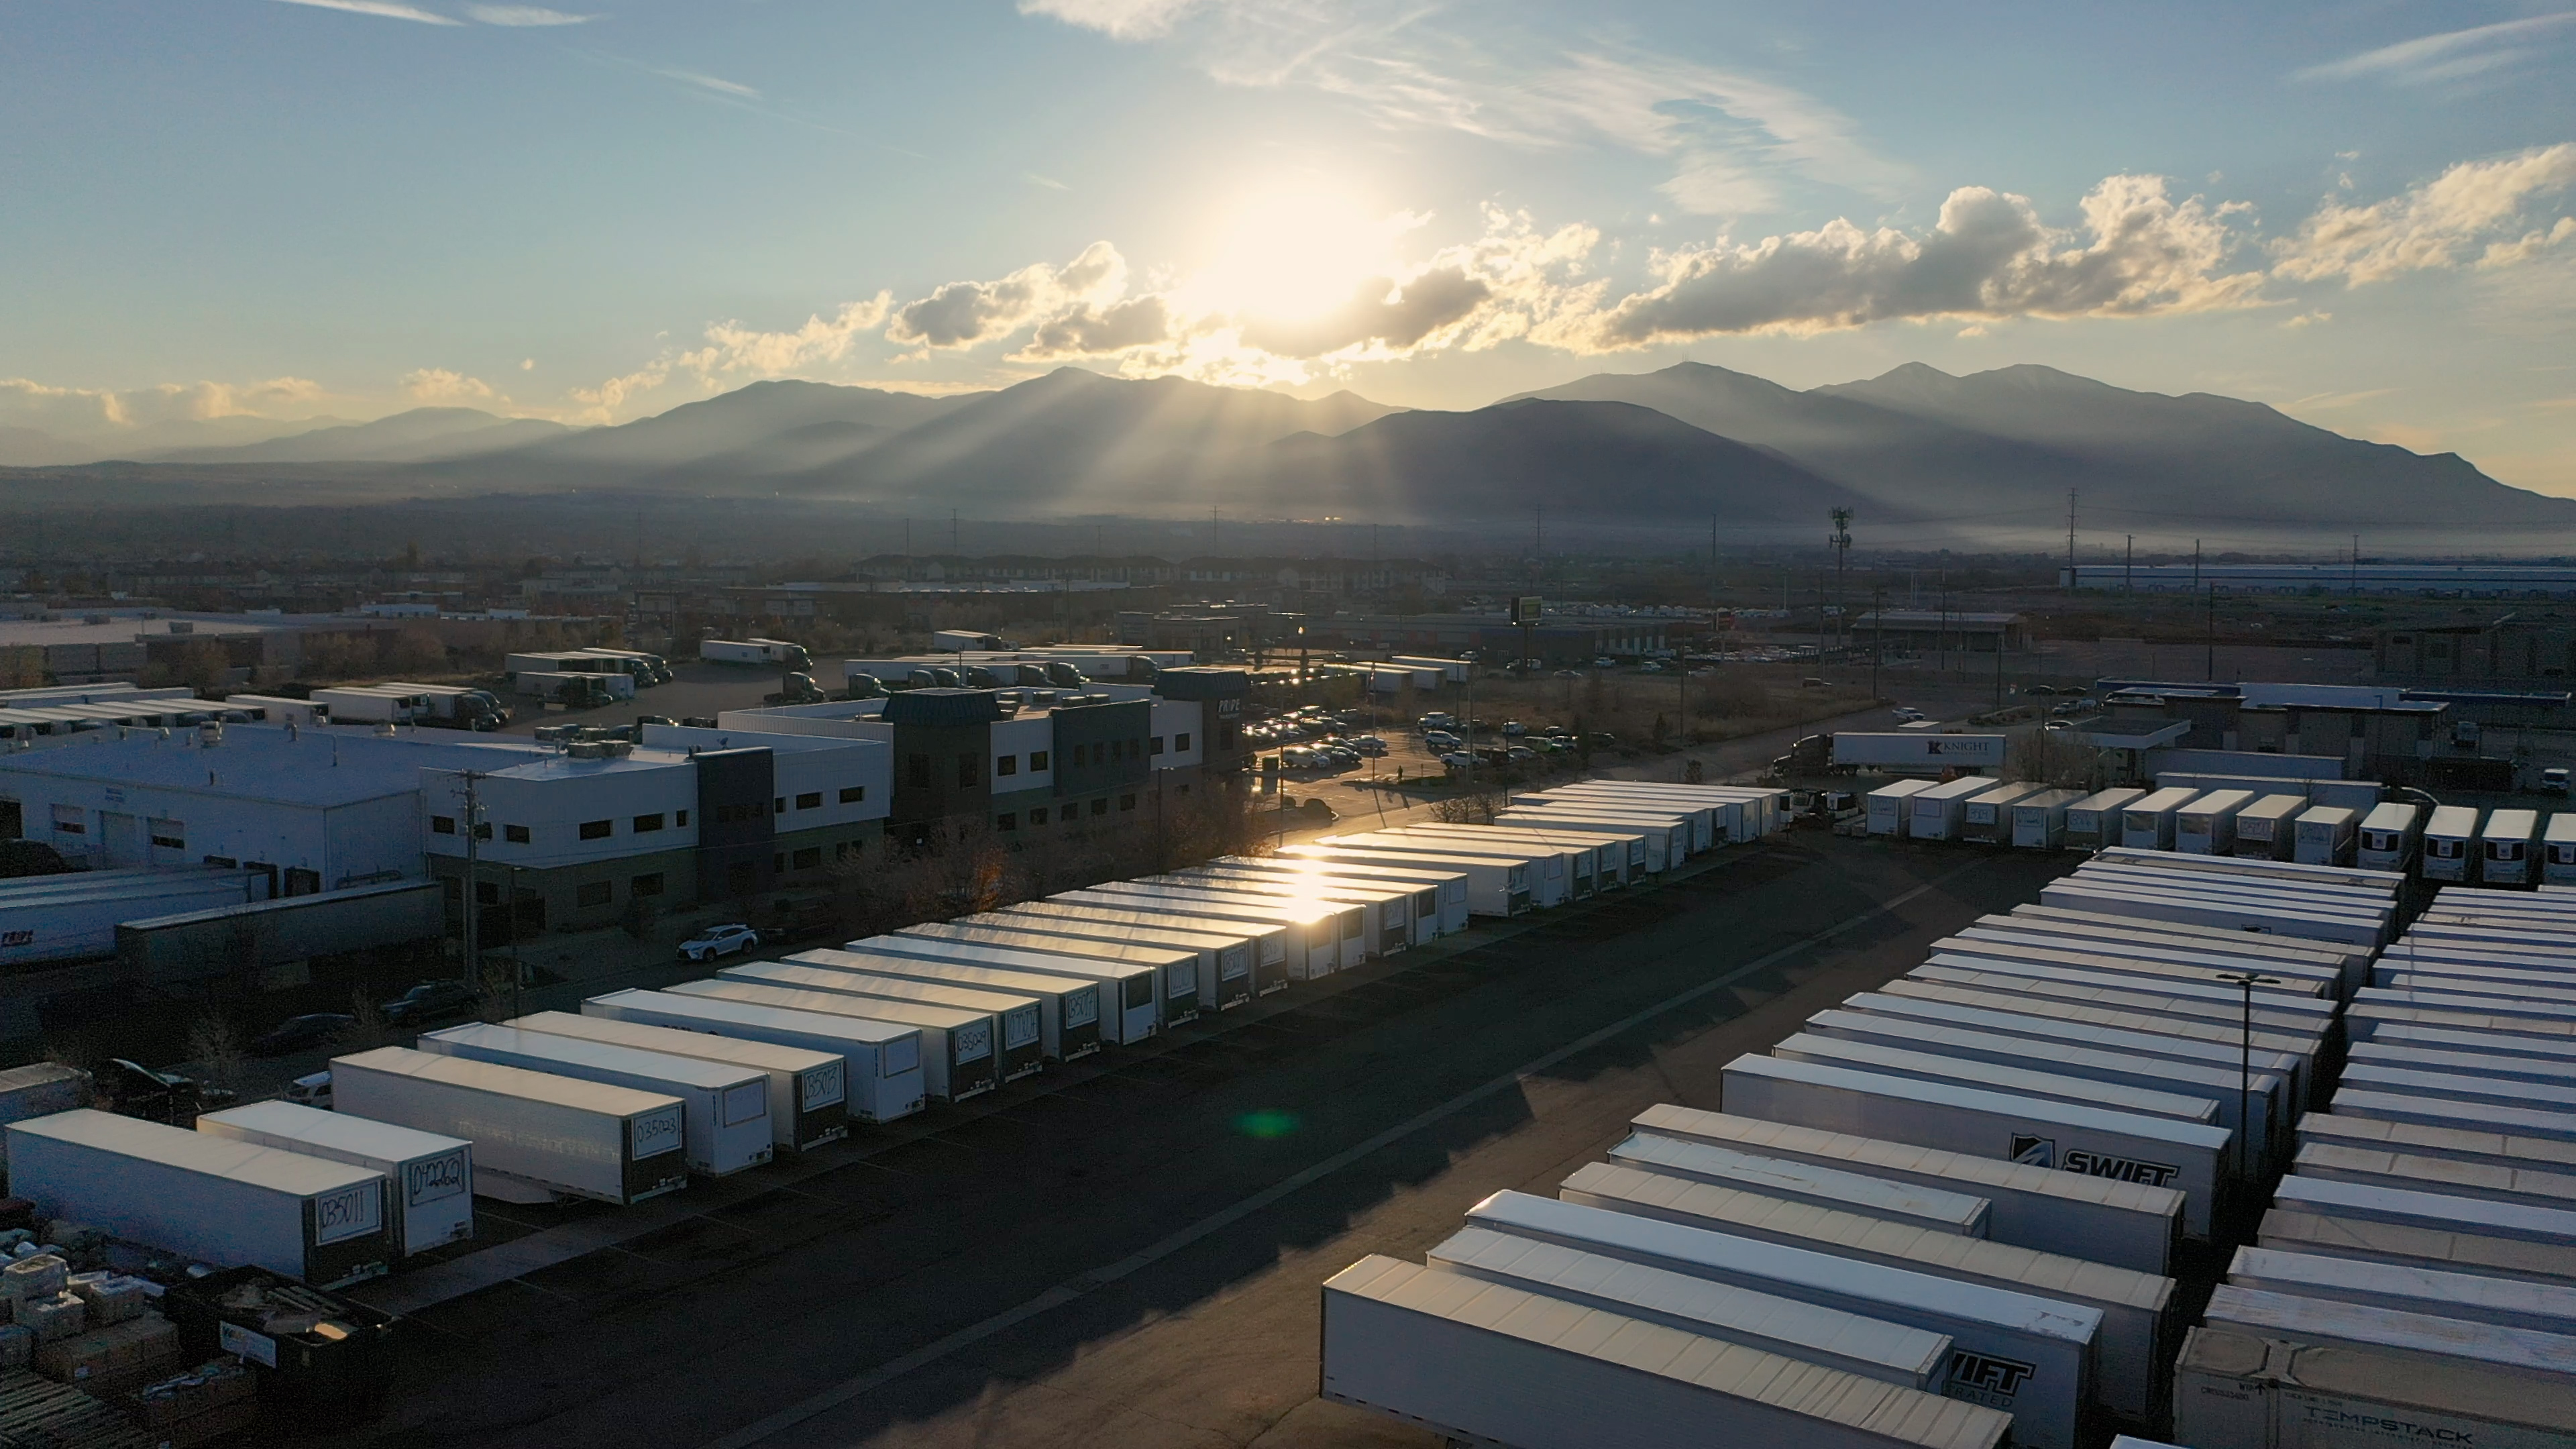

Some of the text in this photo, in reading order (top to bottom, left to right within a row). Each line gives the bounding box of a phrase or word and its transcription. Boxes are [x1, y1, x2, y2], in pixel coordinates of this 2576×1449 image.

[1218, 698, 1240, 712] PRIDE
[1944, 741, 1989, 751] KNIGHT
[957, 1030, 987, 1052] 035029
[637, 1117, 677, 1143] 035023
[413, 1157, 462, 1195] 042262
[2063, 1150, 2179, 1186] SWIFT
[321, 1189, 364, 1228] 035011
[1950, 1385, 2013, 1407] RATED
[2303, 1405, 2473, 1444] TEMPSTACK
